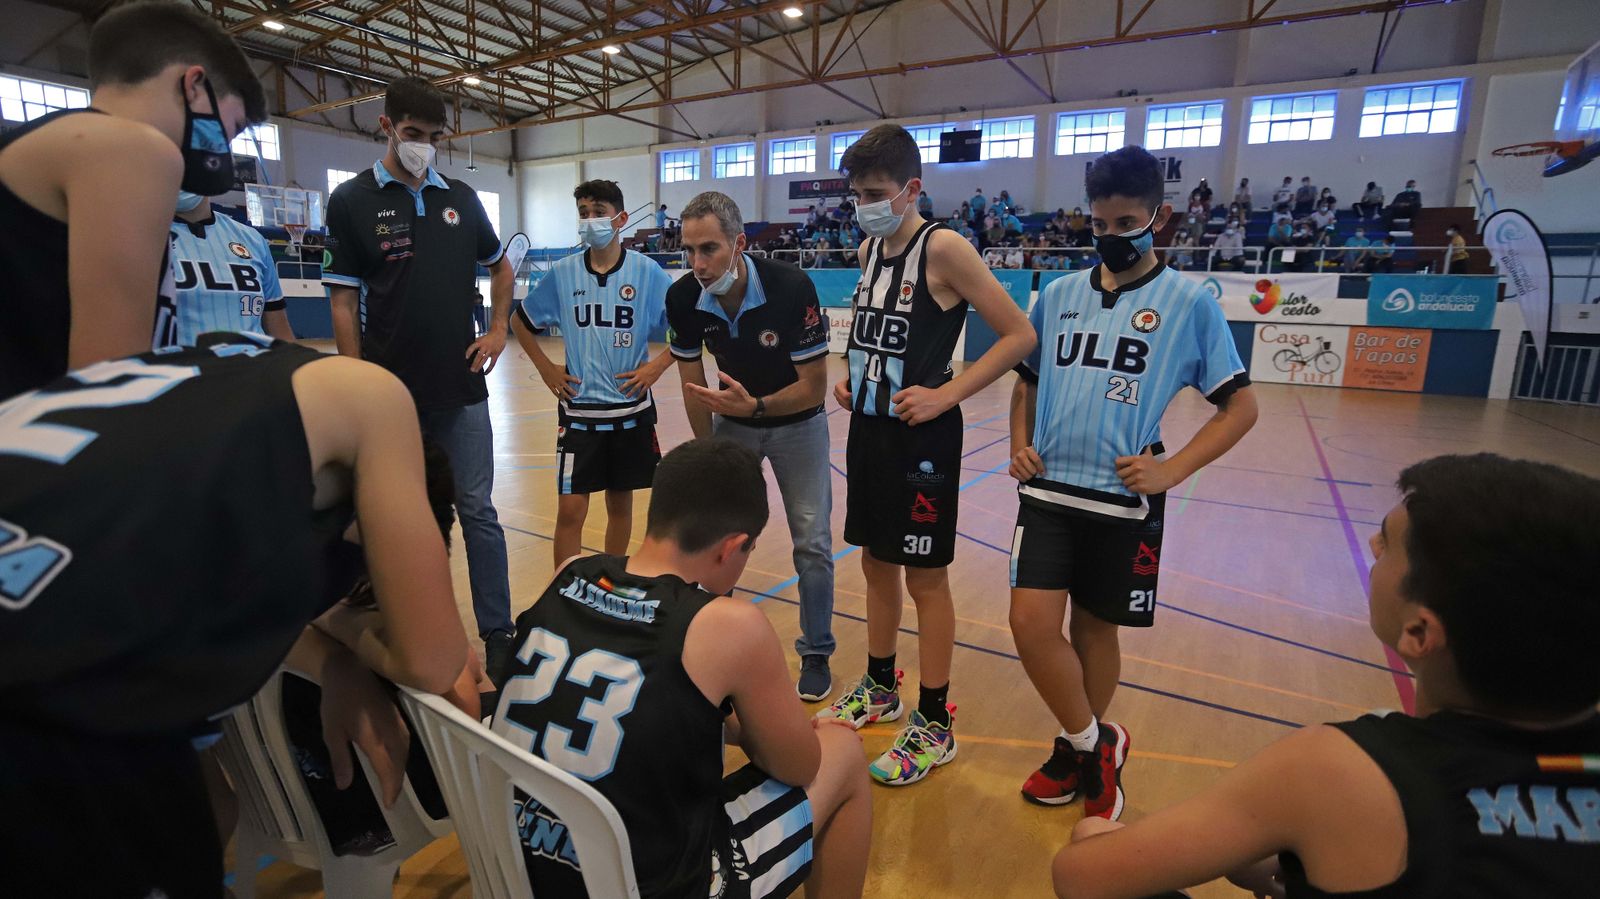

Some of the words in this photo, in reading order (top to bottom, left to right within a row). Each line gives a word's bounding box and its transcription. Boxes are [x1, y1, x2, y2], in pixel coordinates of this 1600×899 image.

[377, 209, 396, 218] vive
[241, 295, 264, 316] 16
[574, 303, 635, 329] ULB
[1060, 310, 1079, 320] vive
[1281, 304, 1321, 316] cesto
[831, 319, 839, 327] La
[854, 311, 910, 354] ULB
[613, 331, 633, 348] 19
[1259, 324, 1311, 344] Casa
[1354, 332, 1390, 347] Bar
[1395, 333, 1422, 349] de
[1056, 331, 1151, 377] ULB
[1353, 347, 1417, 365] Tapas
[1105, 375, 1140, 406] 21
[903, 534, 932, 555] 30
[1129, 589, 1154, 612] 21
[491, 627, 645, 782] 23
[731, 838, 750, 881] vive
